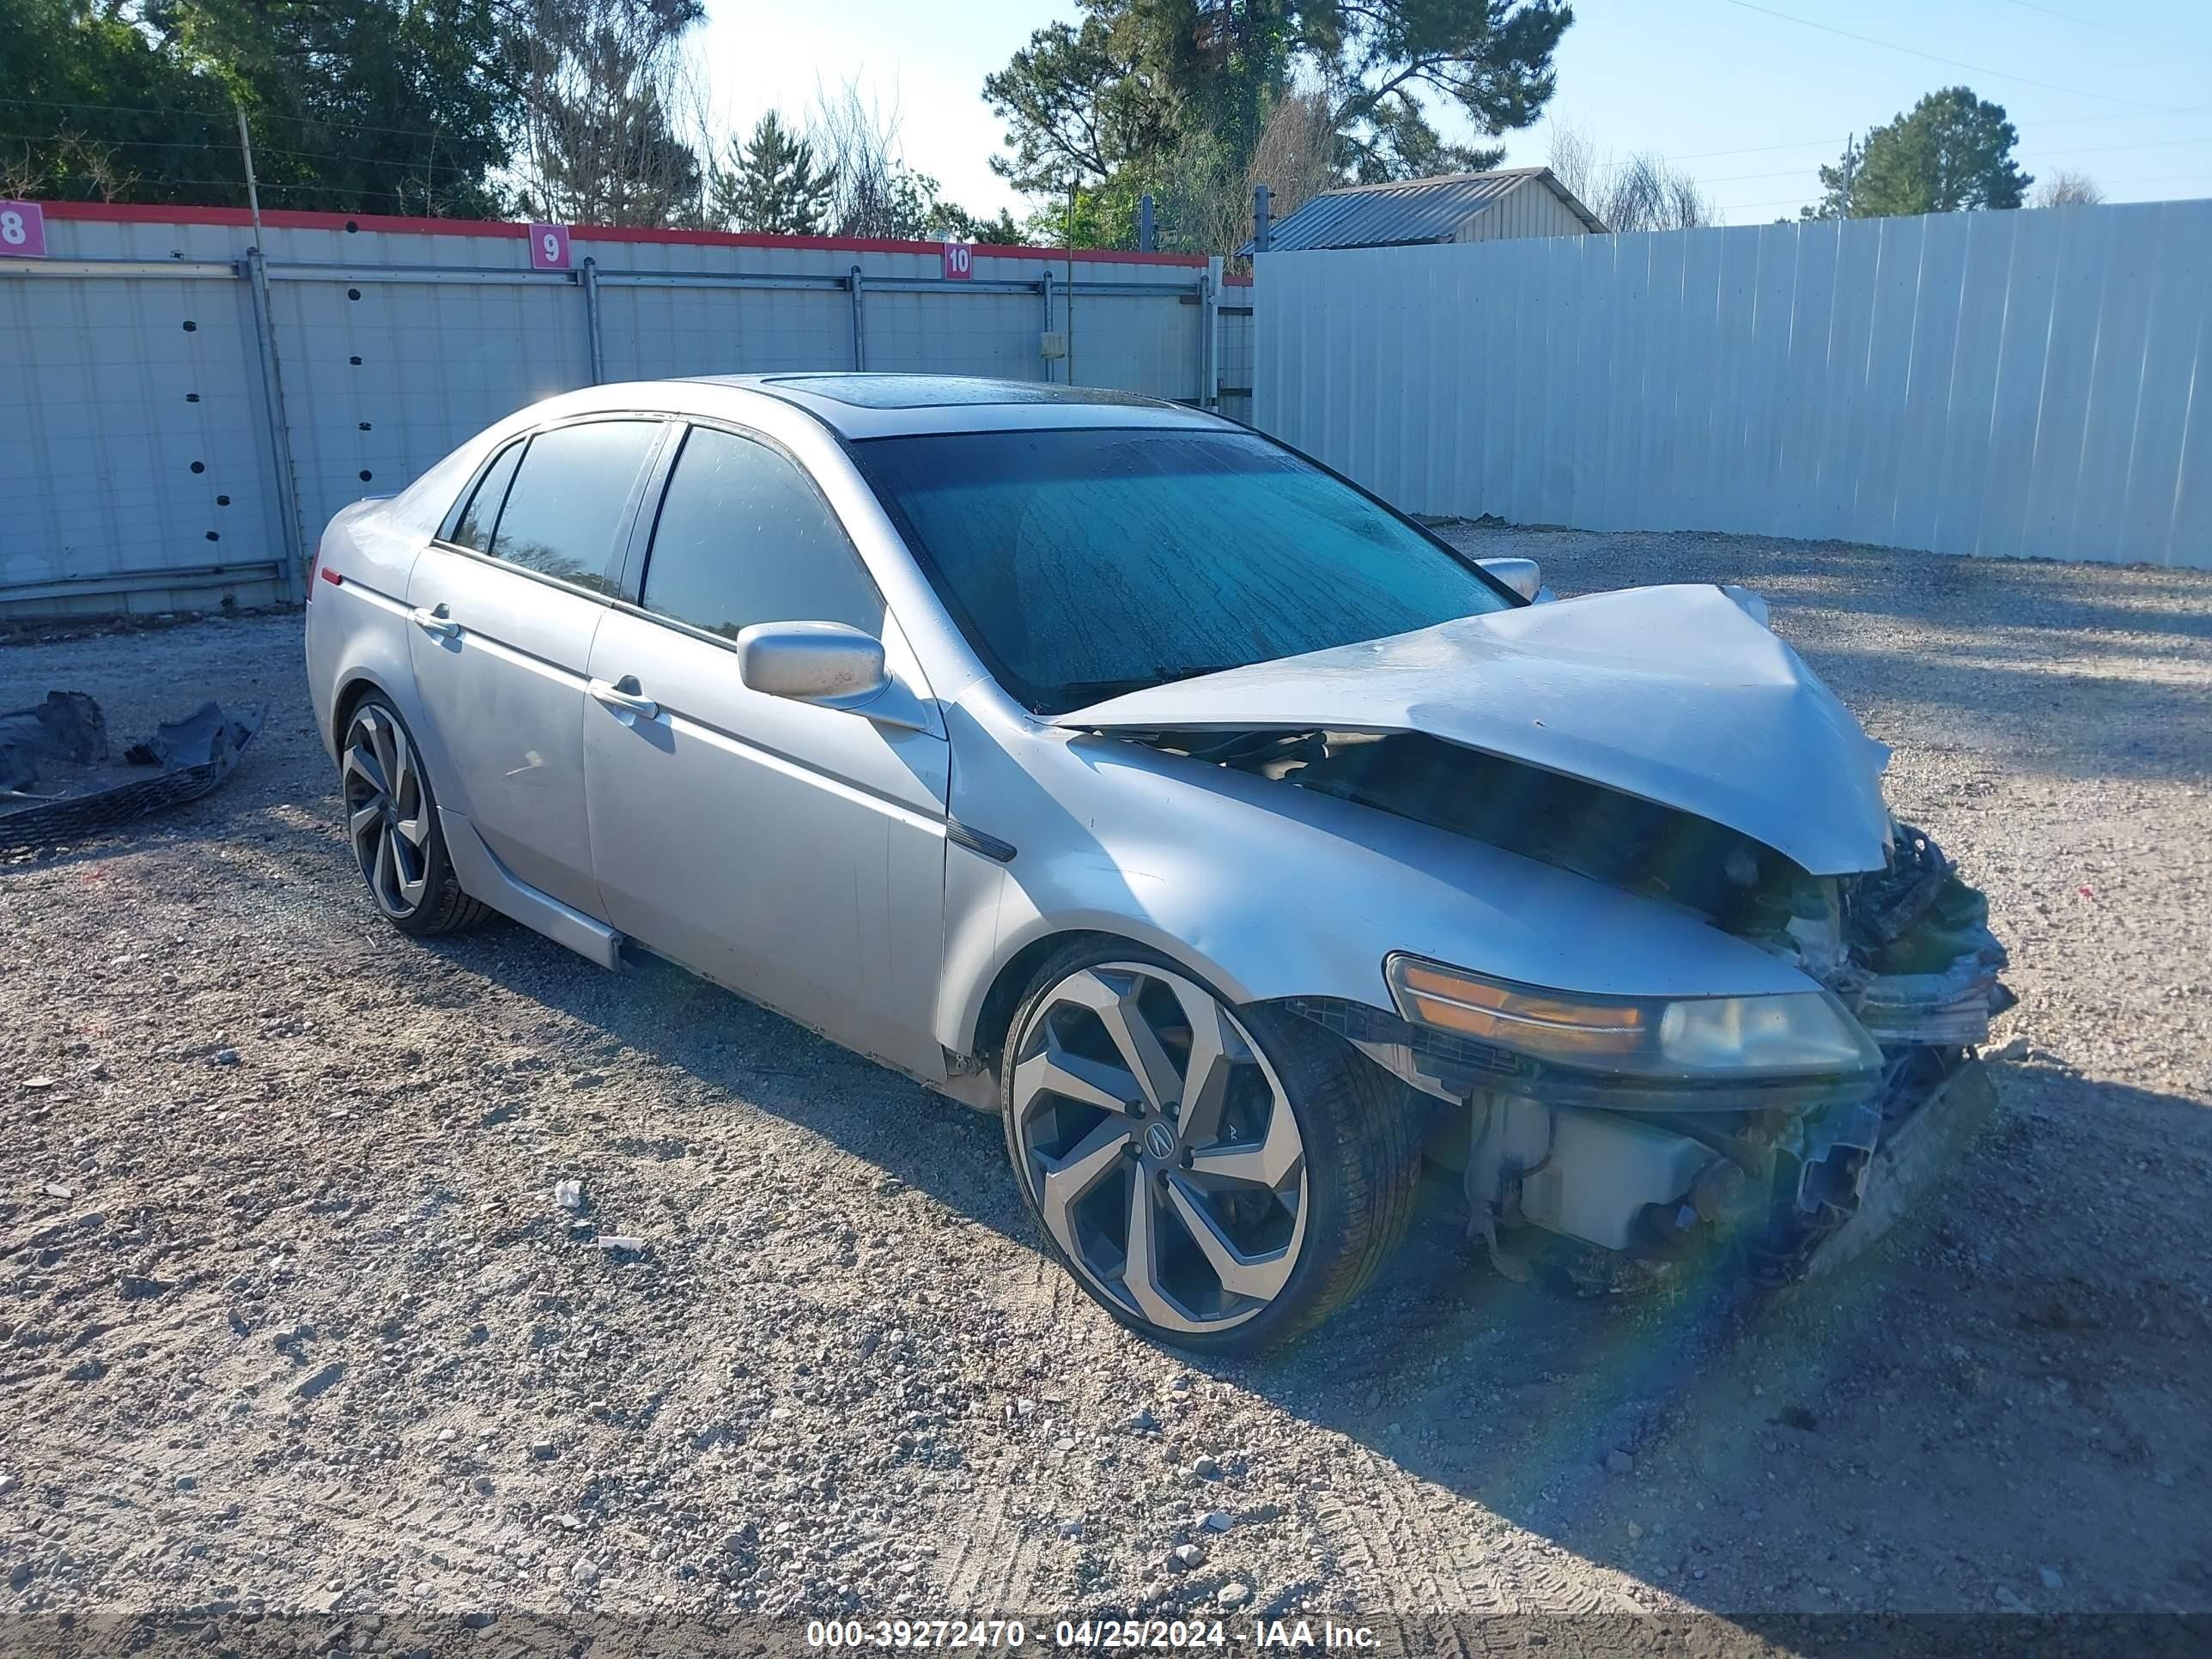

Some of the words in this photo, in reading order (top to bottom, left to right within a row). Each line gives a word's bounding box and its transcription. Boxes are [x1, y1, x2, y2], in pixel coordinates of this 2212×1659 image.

[1, 210, 26, 245] 8
[544, 234, 560, 262] 9
[950, 248, 969, 272] 10
